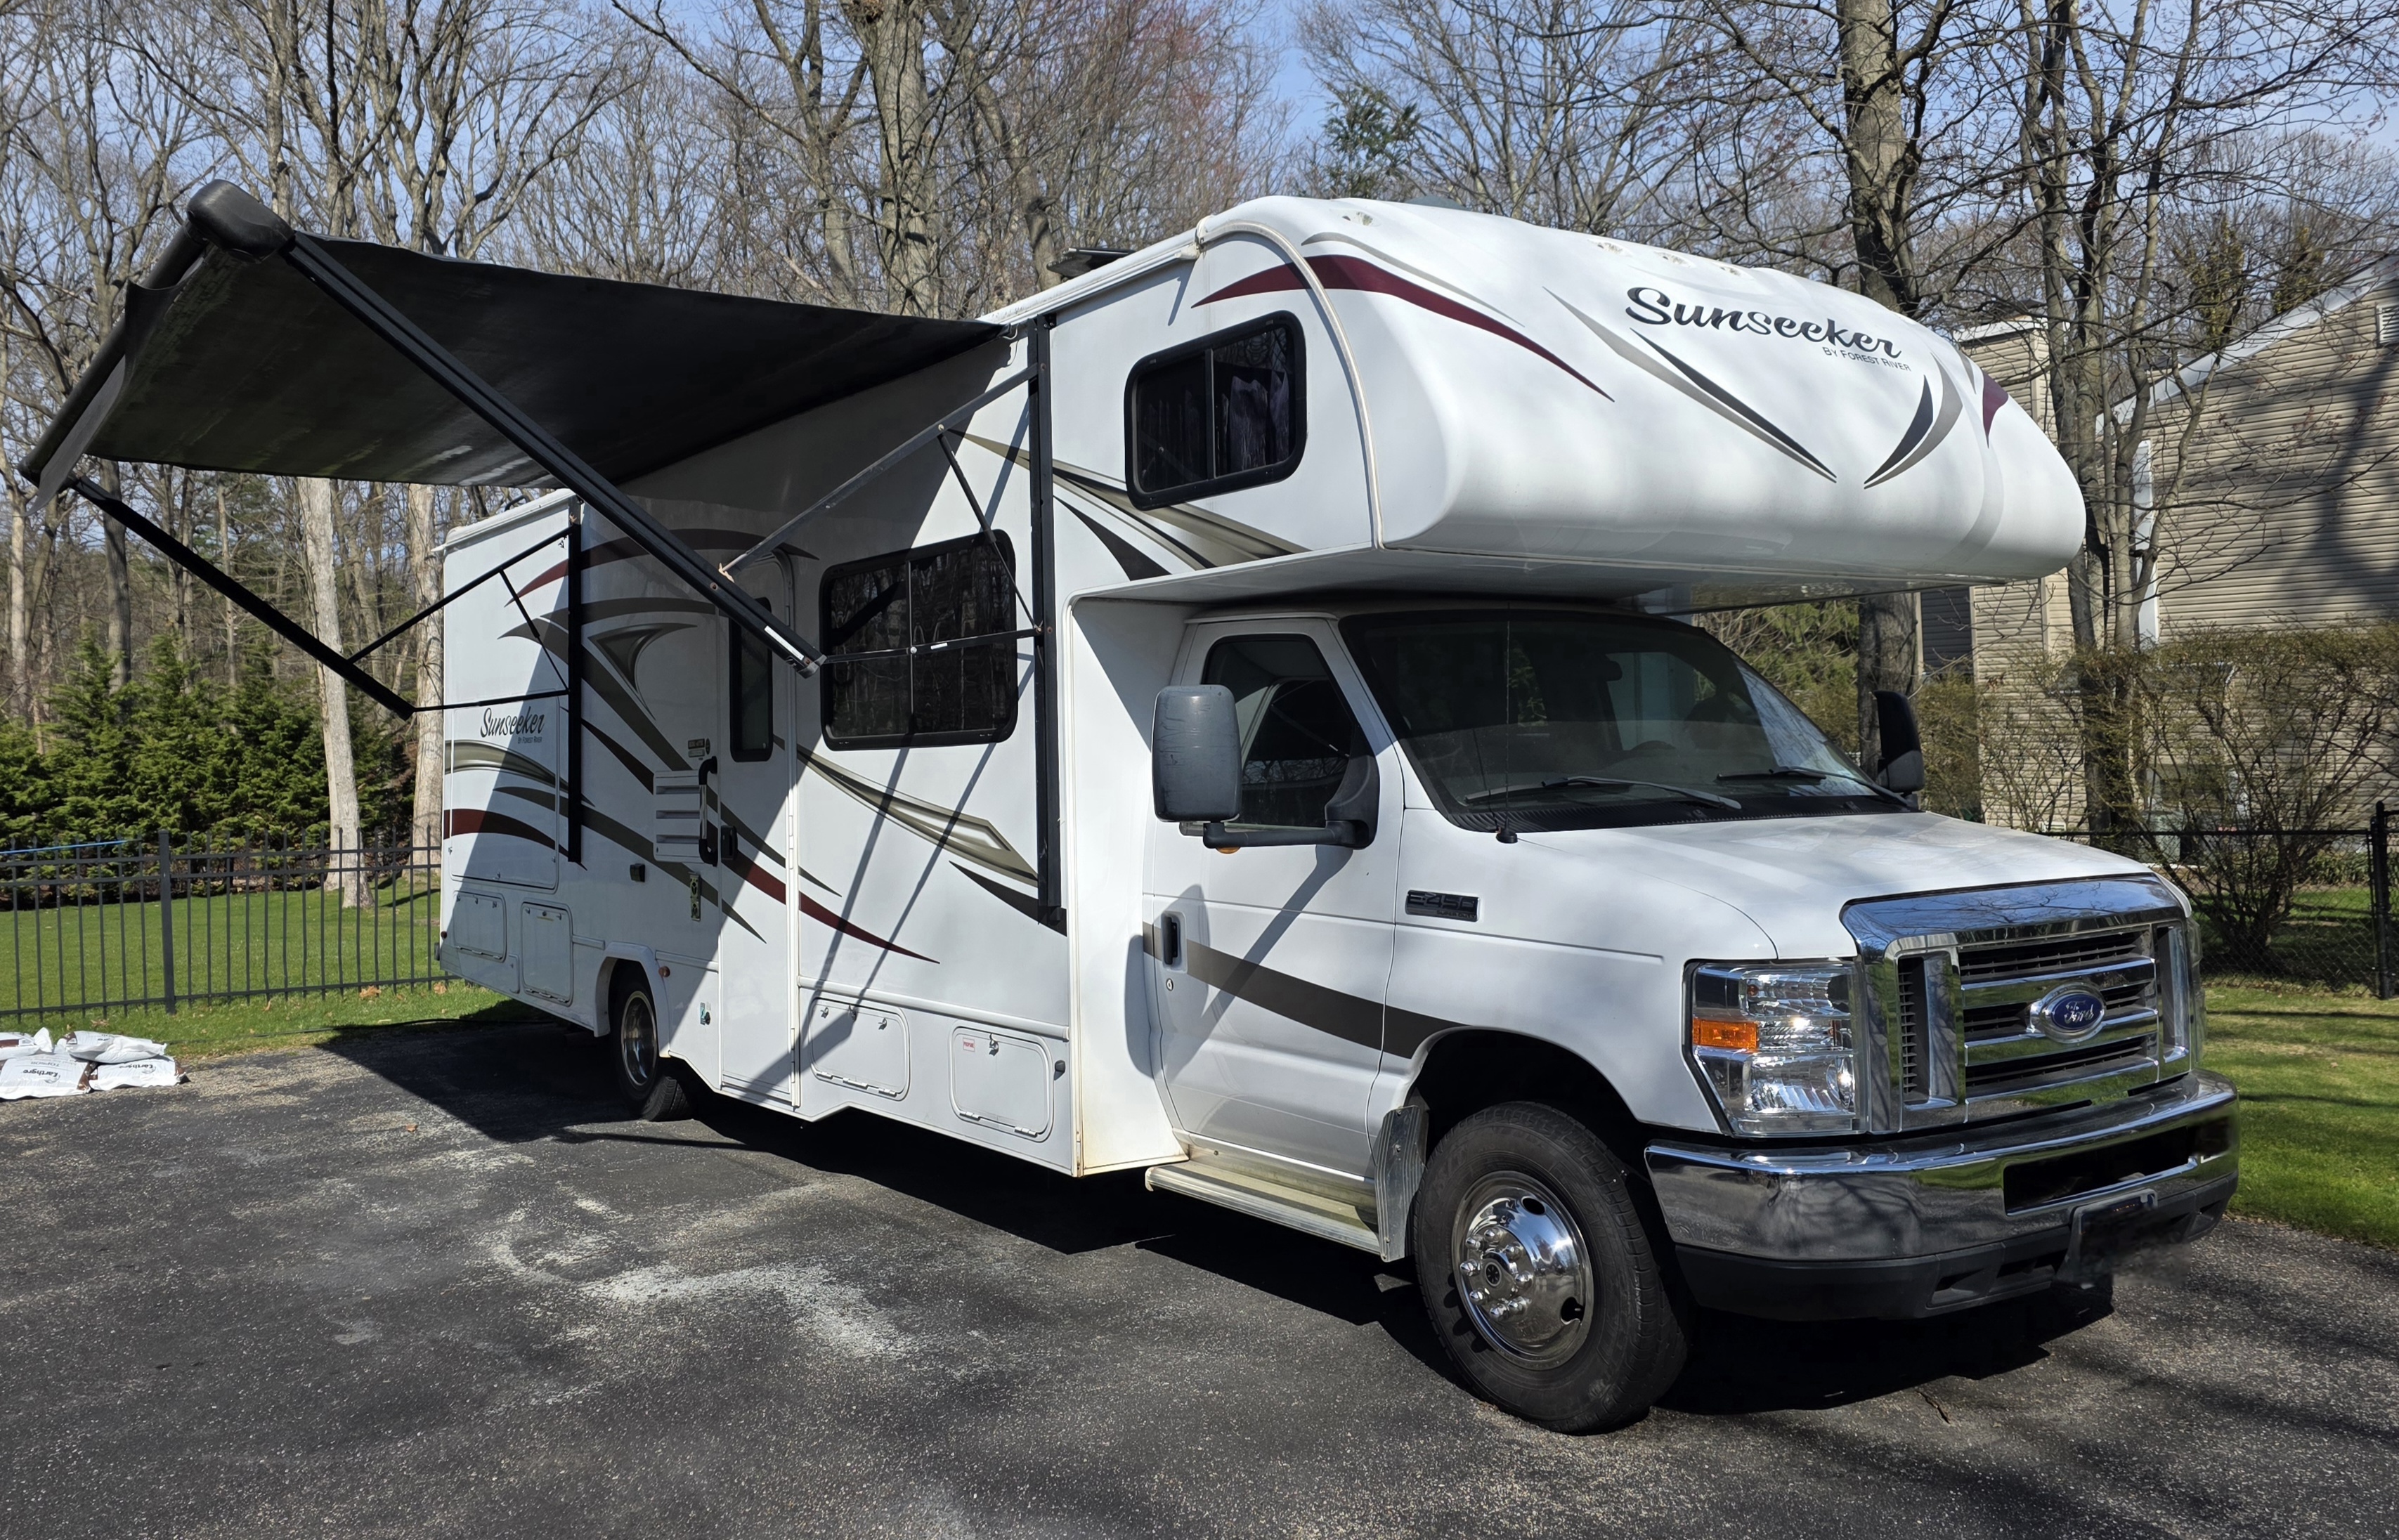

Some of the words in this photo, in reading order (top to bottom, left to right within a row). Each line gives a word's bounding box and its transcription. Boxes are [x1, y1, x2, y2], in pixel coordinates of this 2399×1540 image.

[1625, 287, 1901, 358] Sunseeker
[1822, 346, 1838, 357] BY
[1840, 350, 1880, 365] FOREST
[1881, 358, 1911, 372] RIVER
[481, 706, 545, 738] Sunseeker
[2064, 1000, 2094, 1024] Ford
